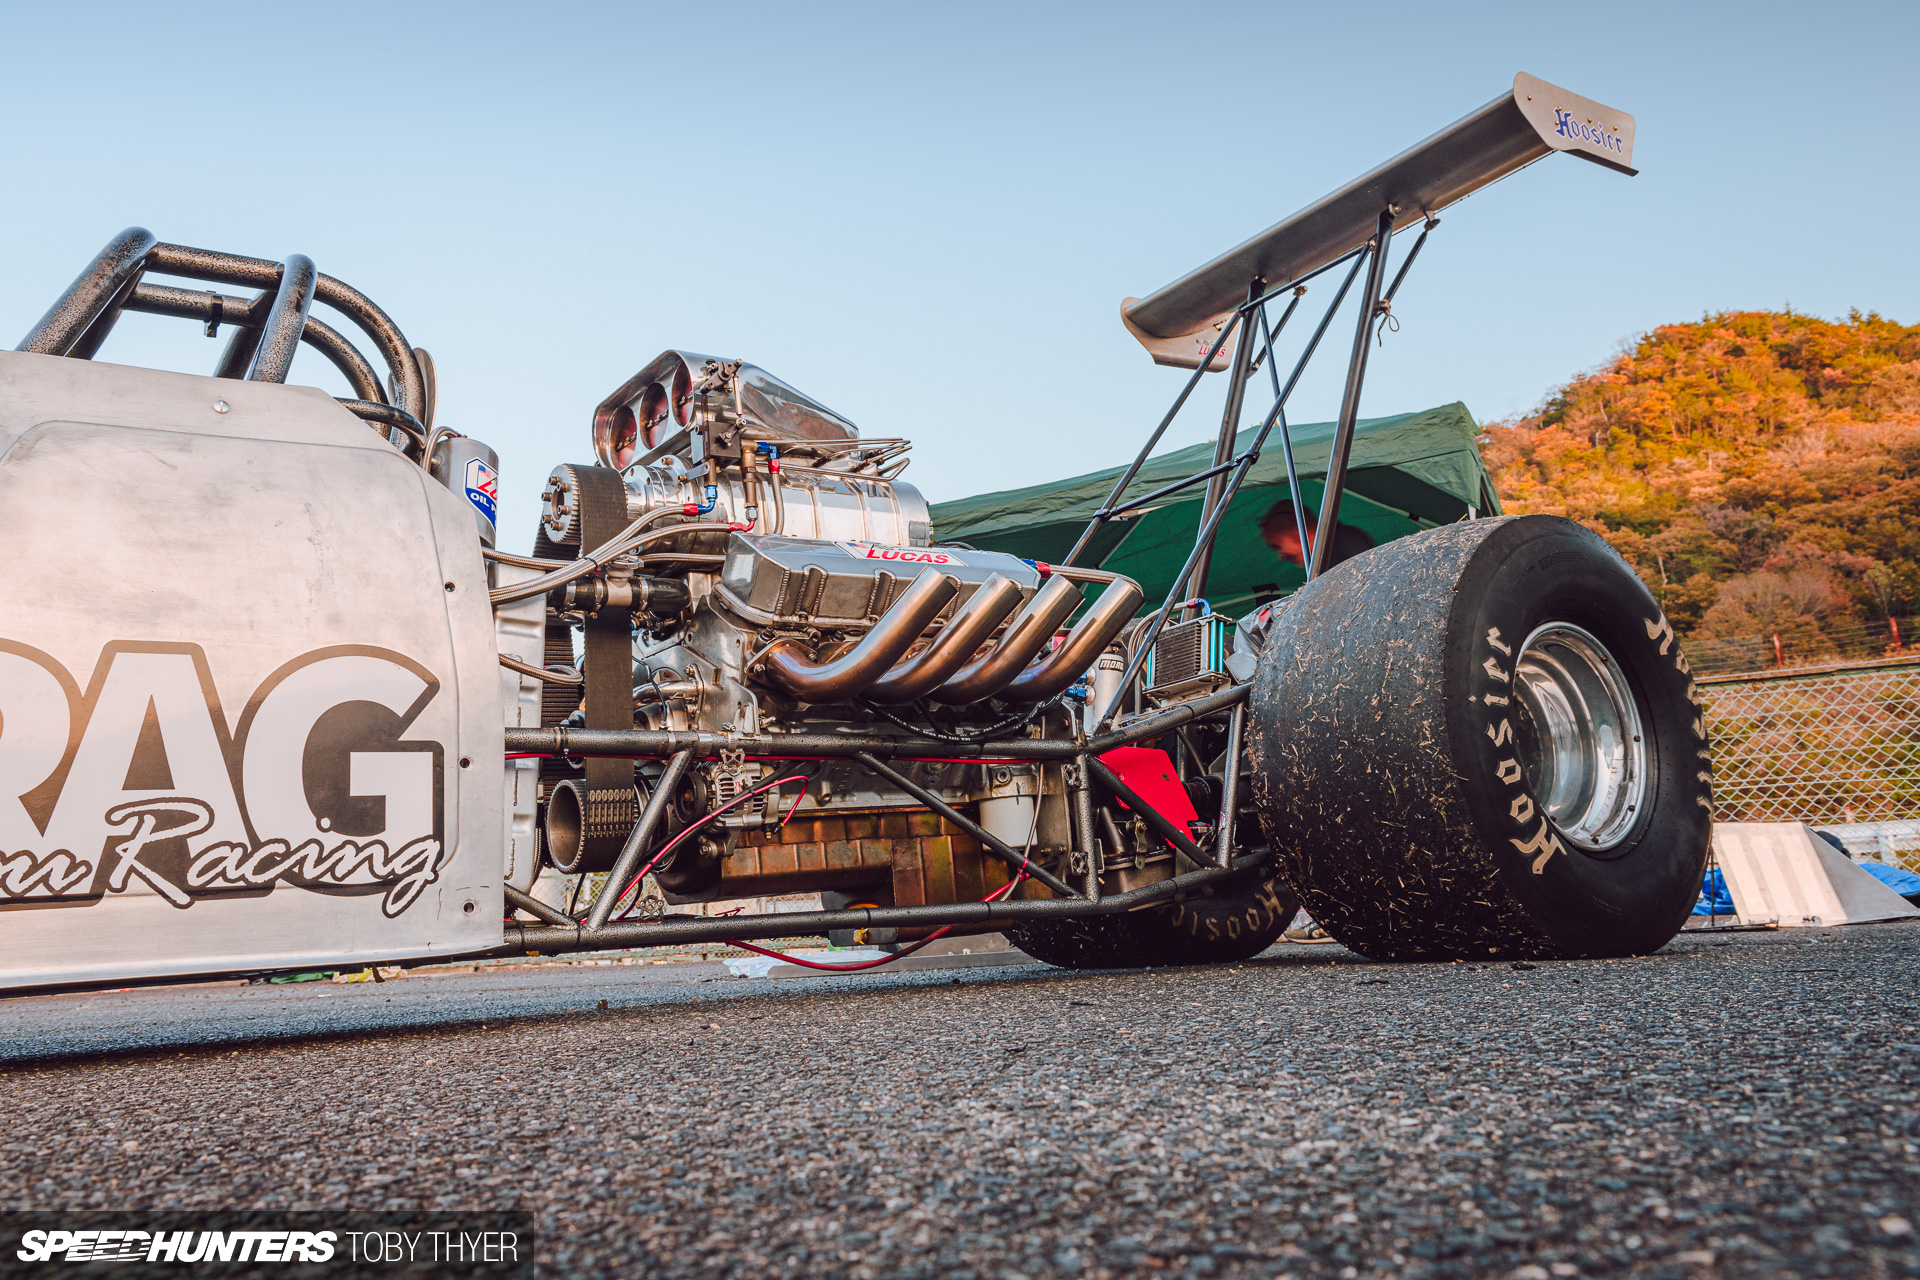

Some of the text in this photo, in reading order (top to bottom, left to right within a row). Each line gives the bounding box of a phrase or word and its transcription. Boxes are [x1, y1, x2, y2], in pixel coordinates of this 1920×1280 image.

[1553, 107, 1623, 154] Hoosier
[1198, 346, 1226, 358] LUS
[470, 492, 490, 507] OIL
[866, 549, 949, 564] LUCAS
[1467, 625, 1568, 876] Hoosier
[105, 797, 441, 918] Racing
